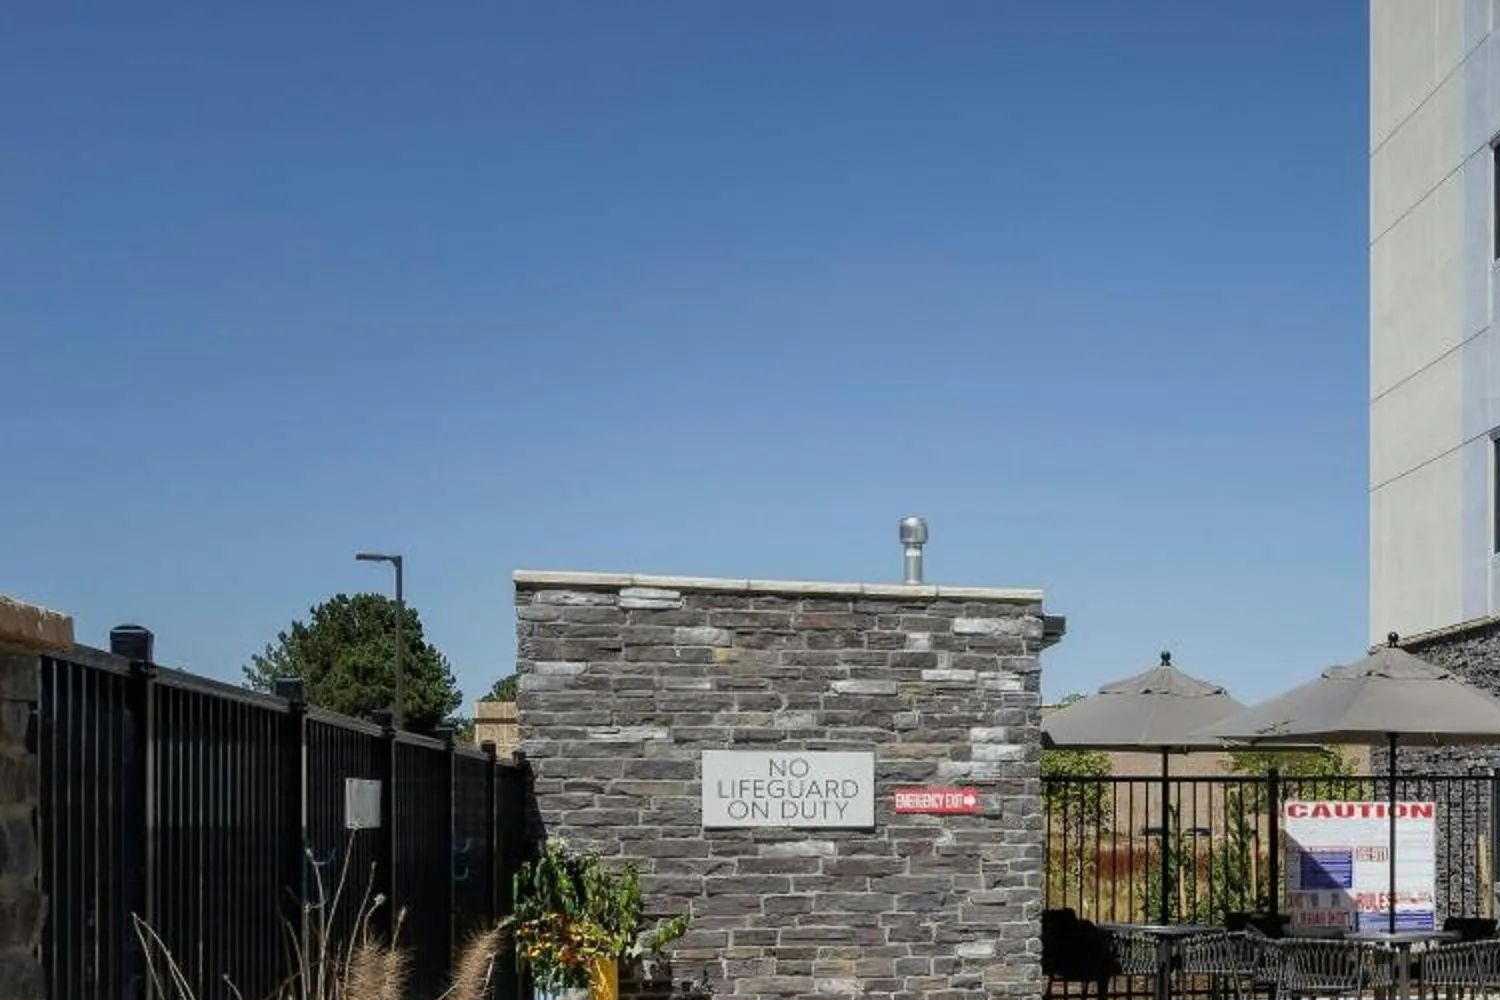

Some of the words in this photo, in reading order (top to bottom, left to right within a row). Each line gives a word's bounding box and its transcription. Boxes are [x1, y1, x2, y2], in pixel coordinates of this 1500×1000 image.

[769, 757, 810, 778] NO
[717, 778, 859, 799] LIFEGUARD
[727, 799, 769, 820] ON
[781, 799, 849, 820] DUTY
[1287, 803, 1433, 818] CAUTION
